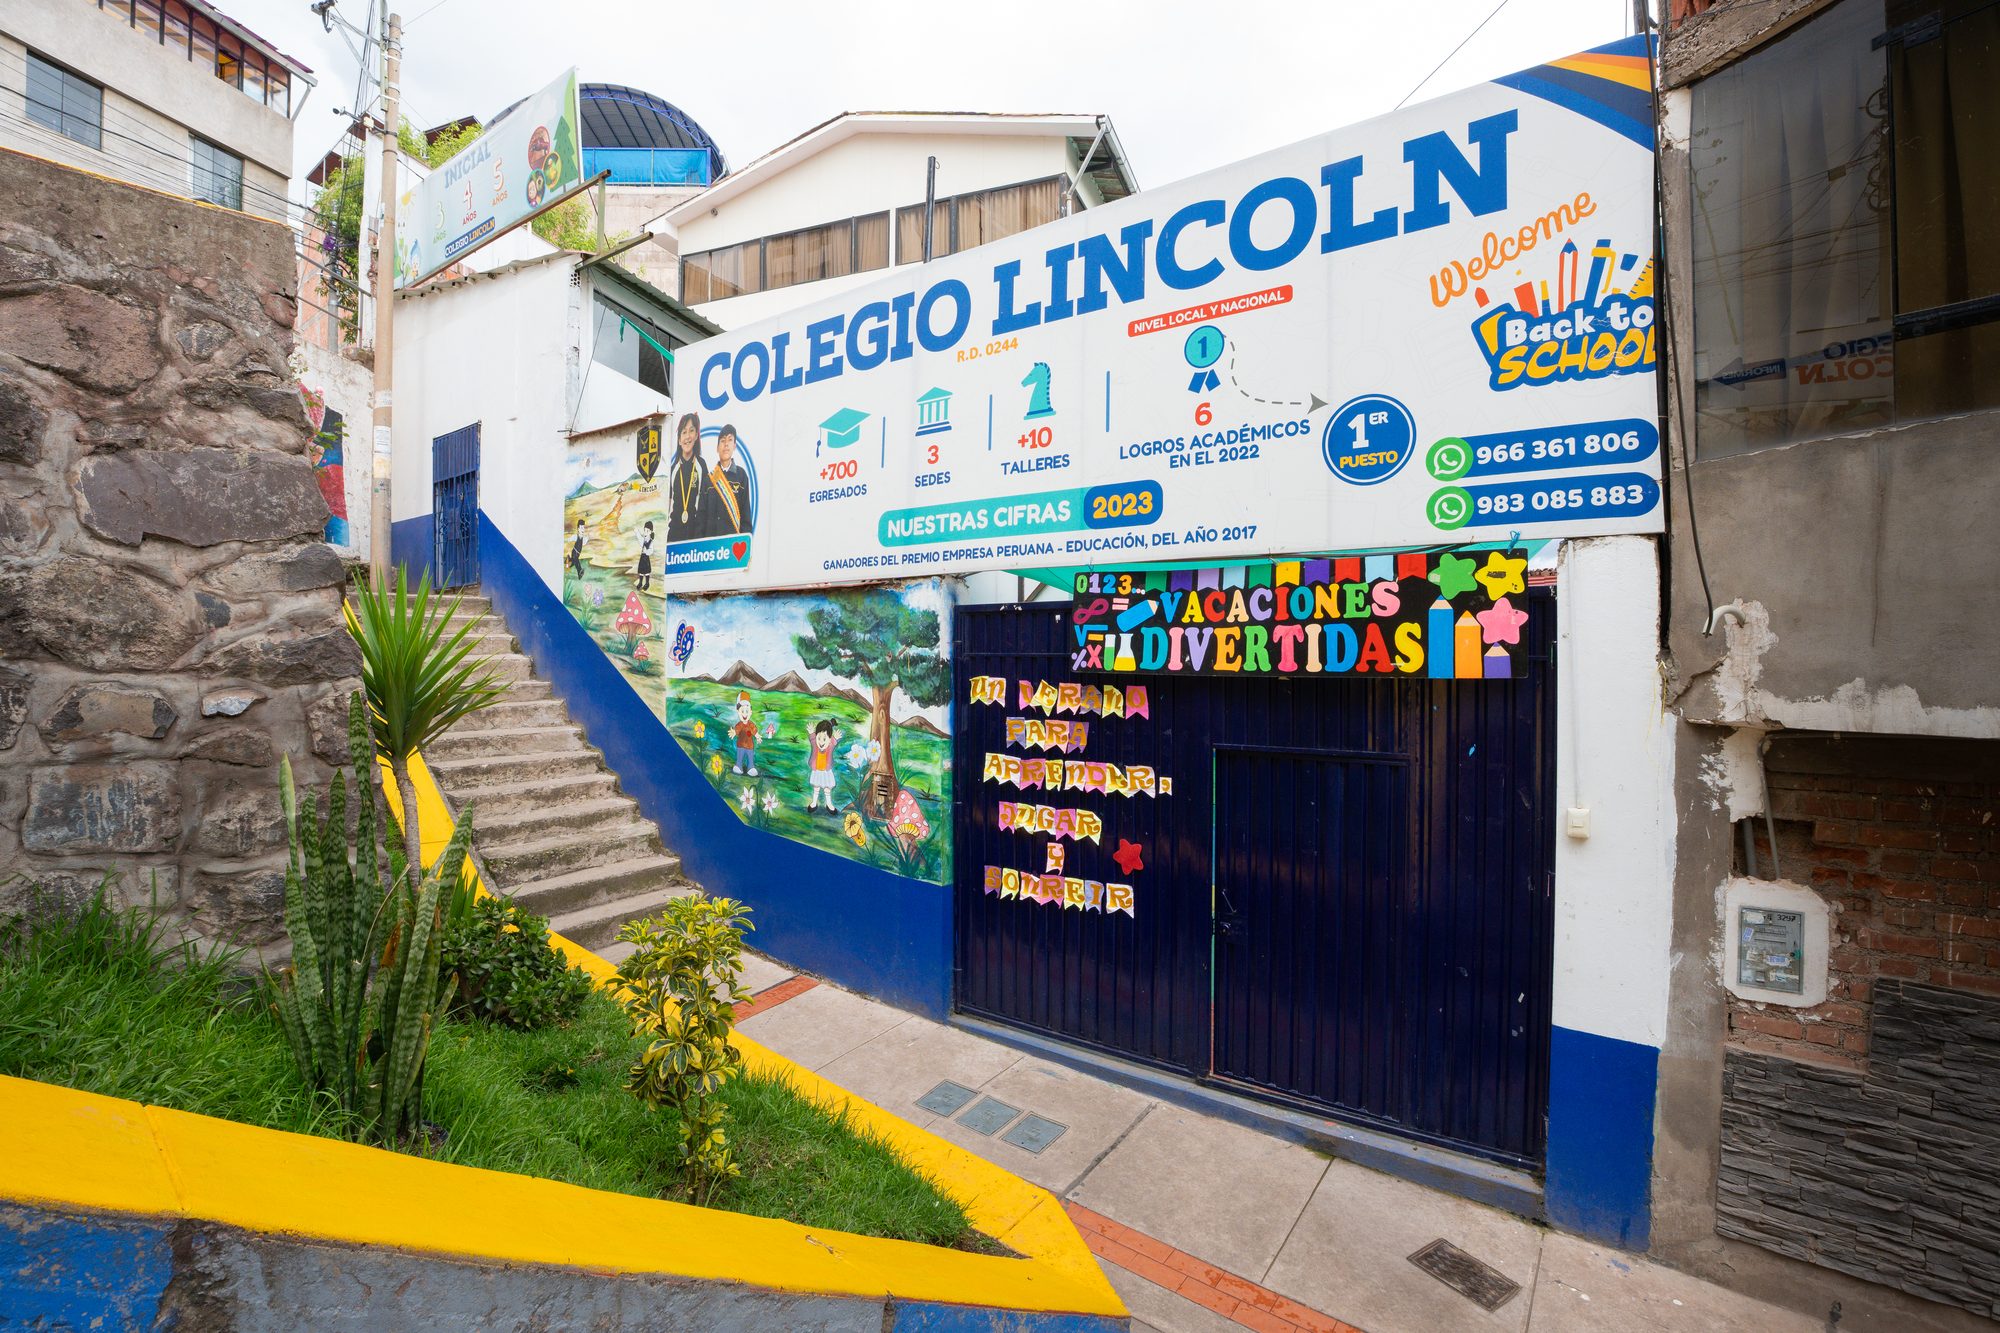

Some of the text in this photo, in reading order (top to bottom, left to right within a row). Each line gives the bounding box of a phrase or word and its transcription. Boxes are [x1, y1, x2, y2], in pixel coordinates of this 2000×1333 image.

[444, 141, 491, 189] INICIAL
[494, 157, 504, 192] 5
[463, 180, 472, 211] 4
[491, 190, 508, 206] AÑOS
[463, 210, 477, 226] AÑOS
[445, 219, 495, 256] COLEGIO LINCOLN
[1429, 191, 1597, 307] Welcome
[699, 109, 1519, 411] COLEGIO LINCOLN
[1134, 291, 1284, 334] NIVEL LOCAL Y NACIONAL
[1505, 302, 1654, 347] Back to
[957, 337, 1019, 363] R.D. 0244
[1199, 335, 1208, 358] 1
[1498, 325, 1656, 384] SCHOOL
[1194, 402, 1213, 426] 6
[1017, 426, 1053, 449] +10
[1119, 418, 1311, 460] LOGROS ACADÉMICOS
[1476, 431, 1640, 465] 966 361 806
[927, 444, 939, 465] 3
[1001, 454, 1071, 475] TALLERES
[1169, 444, 1260, 469] EN EL 2022
[1339, 450, 1399, 470] PUESTO
[819, 459, 858, 481] +700
[914, 471, 951, 488] SEDES
[639, 484, 658, 493] LINCOLN
[808, 484, 868, 503] EGRESADOS
[1477, 484, 1643, 514] 983 085 883
[888, 491, 1153, 538] NUESTRAS CIFRAS 2023
[666, 546, 730, 566] Lincolinos de
[823, 556, 879, 571] GANADORES
[881, 554, 899, 567] DEL
[901, 551, 940, 565] PREMIO
[942, 547, 993, 562] EMPRESA
[997, 542, 1054, 557] PERUANA
[1066, 532, 1148, 553] EDUCACIÓN,
[1151, 532, 1180, 546] DEL
[1183, 526, 1218, 544] AÑO
[1222, 525, 1257, 541] 2017
[1160, 581, 1401, 624] VACACIONES
[1140, 622, 1425, 673] DIVERTIDAS
[1007, 719, 1087, 746] PARA
[1000, 803, 1101, 836] JUGAR
[985, 867, 1133, 909] SONREIR
